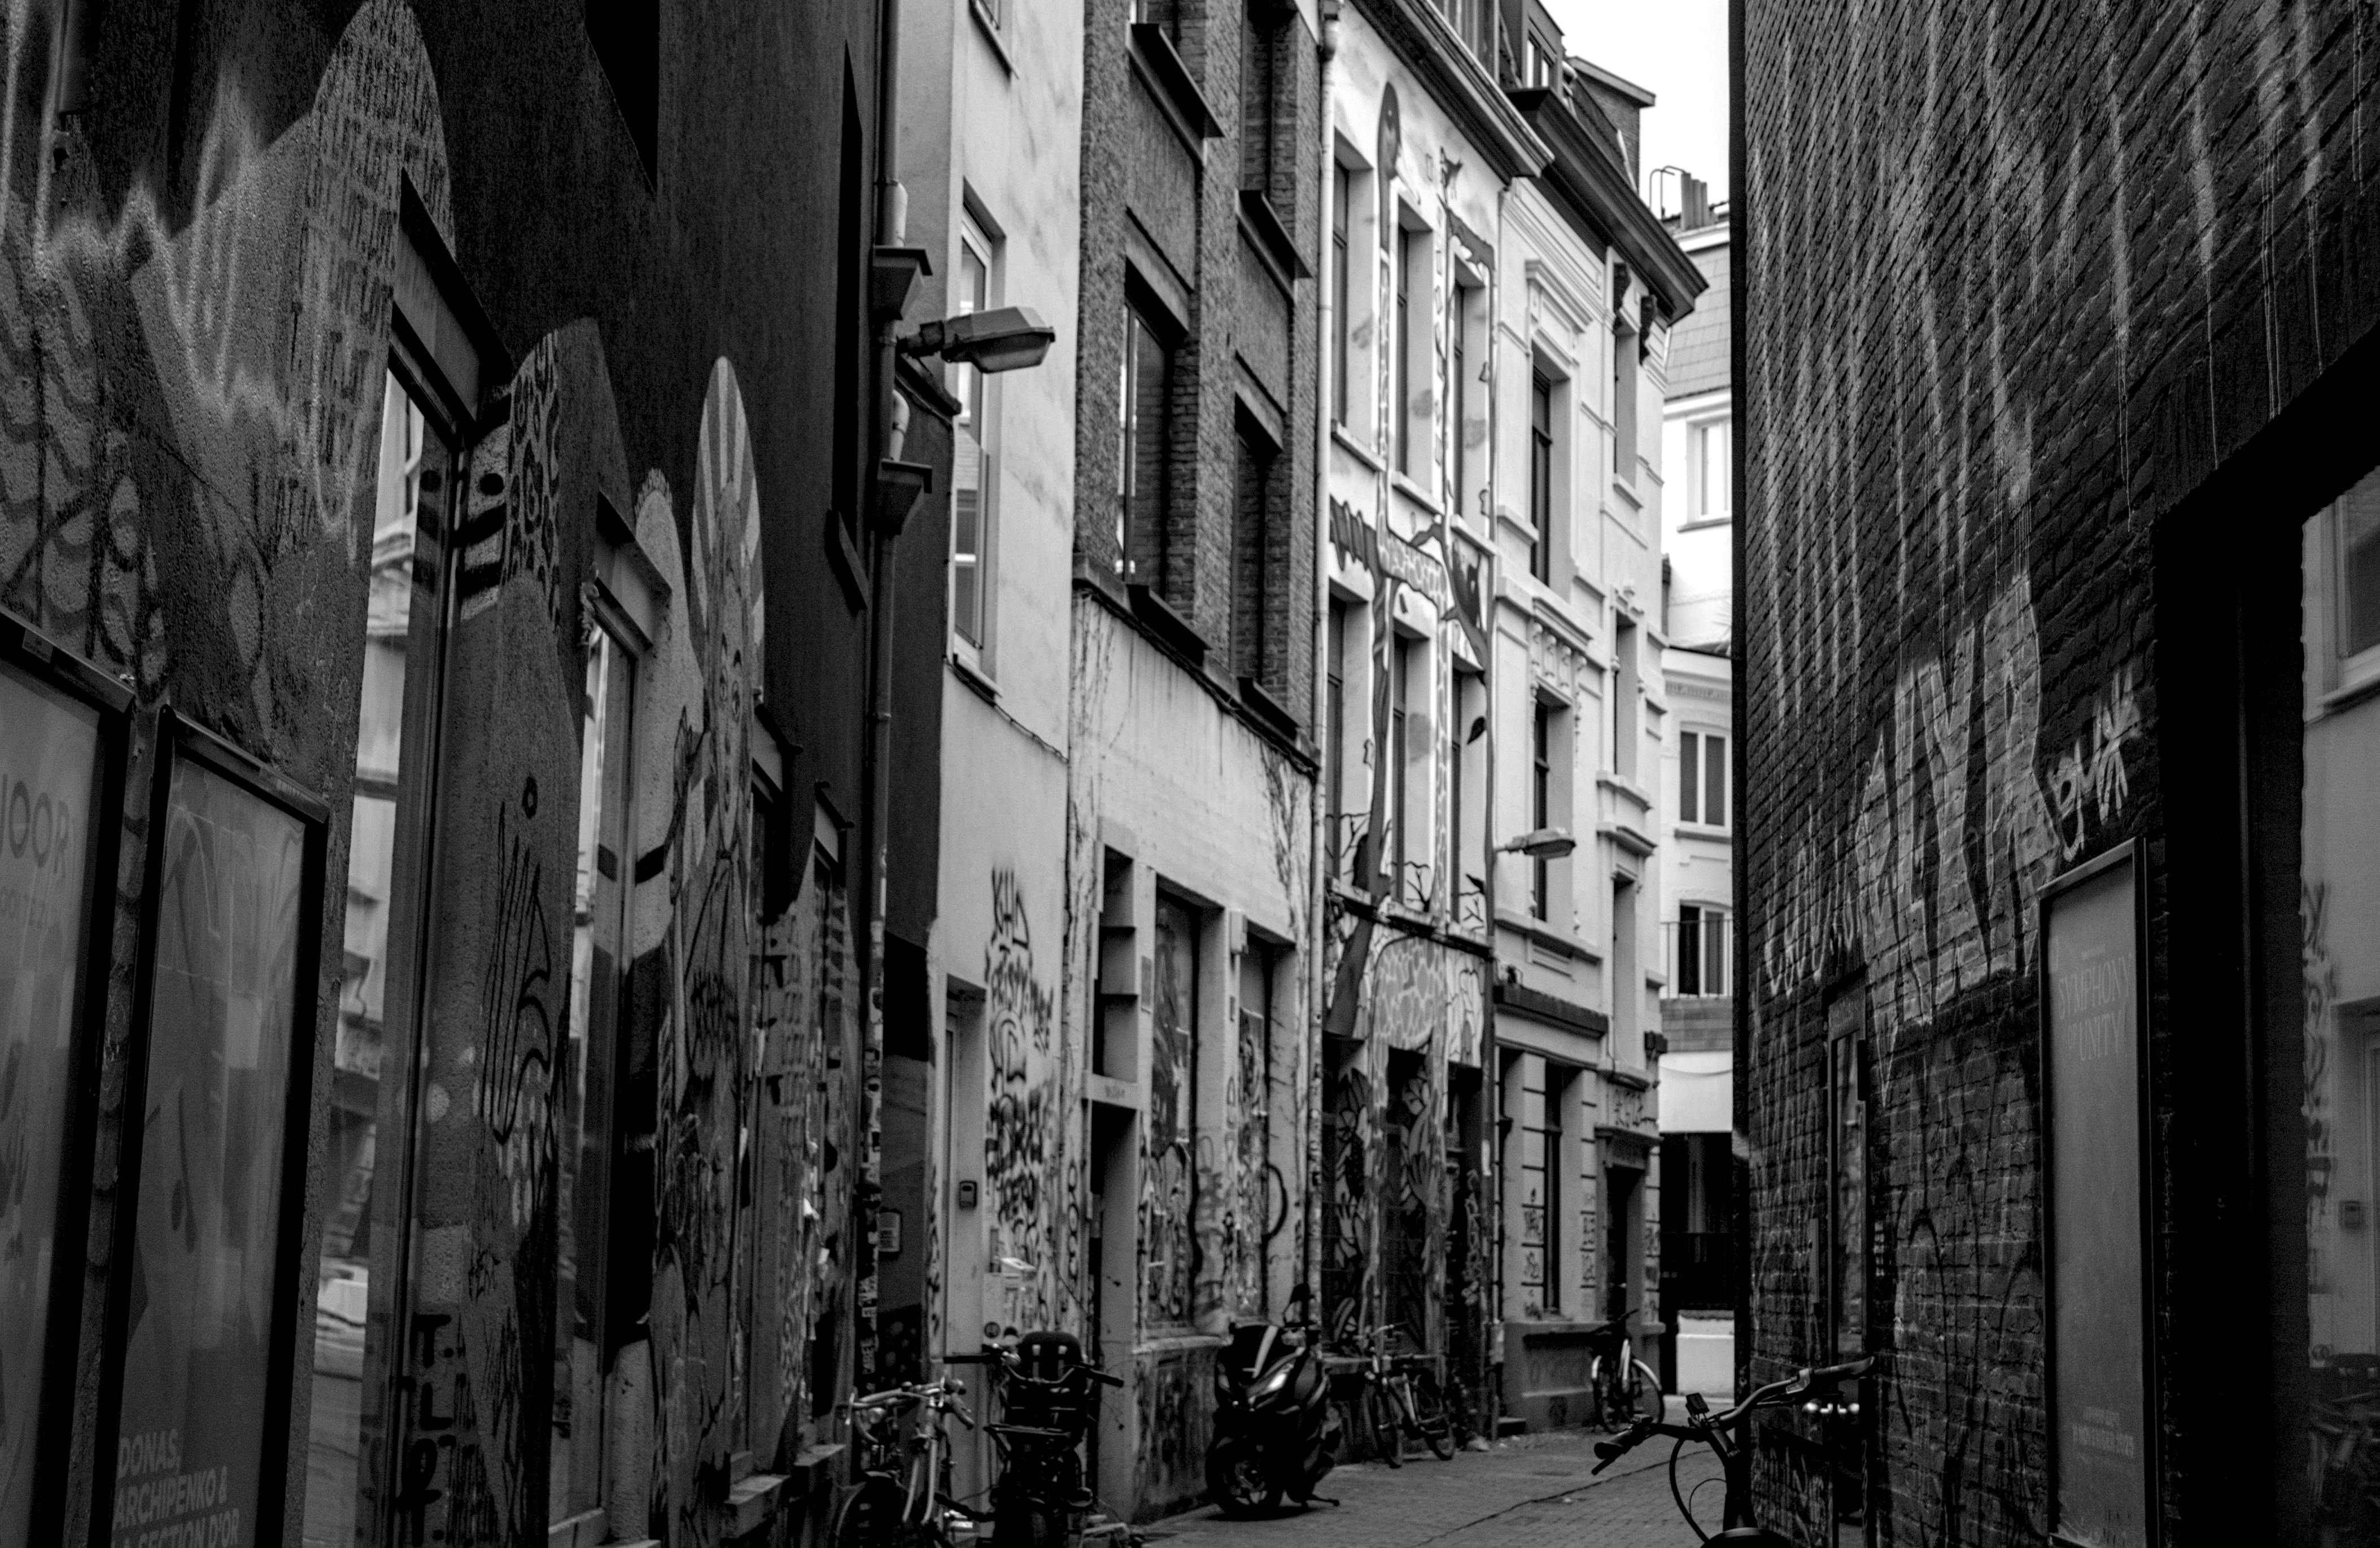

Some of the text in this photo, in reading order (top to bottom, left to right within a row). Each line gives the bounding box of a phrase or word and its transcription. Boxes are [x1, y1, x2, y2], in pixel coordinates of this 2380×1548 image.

[0, 773, 69, 880] OOR
[2058, 952, 2132, 1020] SYMPHONY
[2078, 1009, 2121, 1061] UNITY
[117, 1428, 181, 1479] DONAS,
[112, 1468, 217, 1531] ARCHIPENKO
